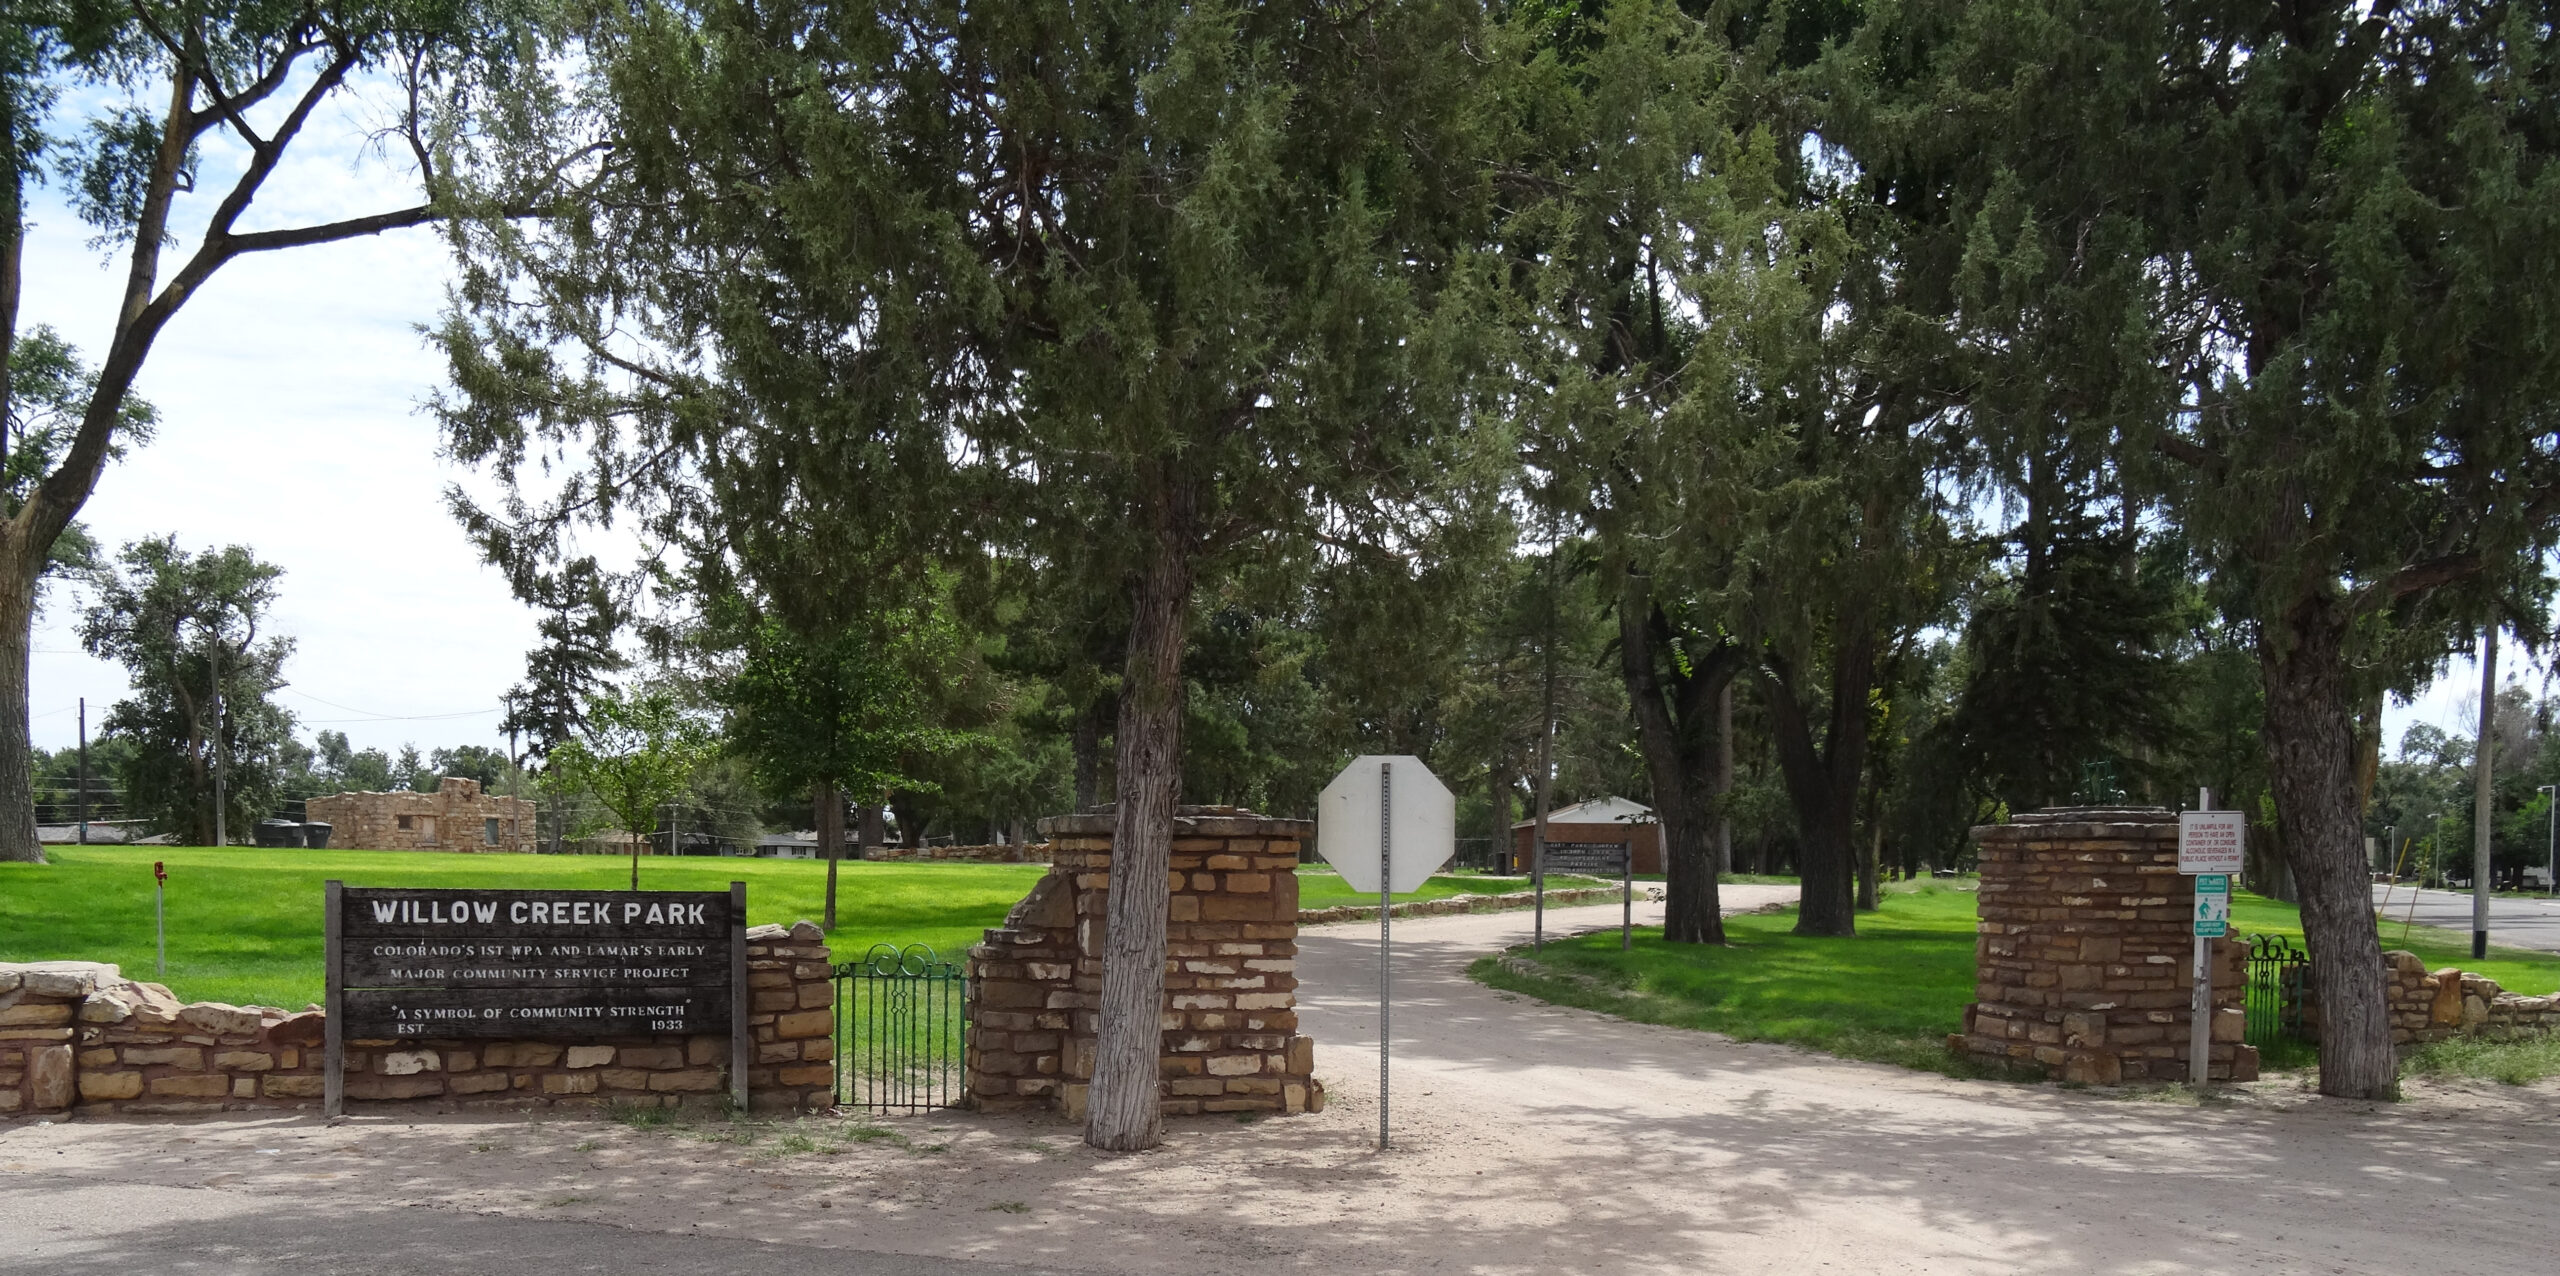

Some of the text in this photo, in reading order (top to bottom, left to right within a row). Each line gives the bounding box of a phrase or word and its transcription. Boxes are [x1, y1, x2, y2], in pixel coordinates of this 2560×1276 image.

[2188, 831, 2203, 839] PERSON
[2210, 831, 2219, 839] HAVE
[2225, 831, 2235, 839] OPEN
[2206, 847, 2228, 855] BEVERAGES
[2180, 855, 2194, 863] PUBLIC
[2194, 855, 2207, 863] PLACE
[372, 900, 705, 925] WILLOW CREEK PARK
[373, 944, 475, 957] COLORADO'S
[512, 945, 543, 957] WPA
[550, 946, 580, 957] AND
[587, 945, 652, 957] LAMAR'S
[658, 946, 705, 957] EARLY
[391, 968, 690, 979] MAJOR COMMUNITY SERVICE PROJECT
[414, 1008, 476, 1020] SYMBOL
[483, 1008, 503, 1019] OF
[510, 1007, 603, 1019] COMMUNITY
[651, 1020, 683, 1031] 1933
